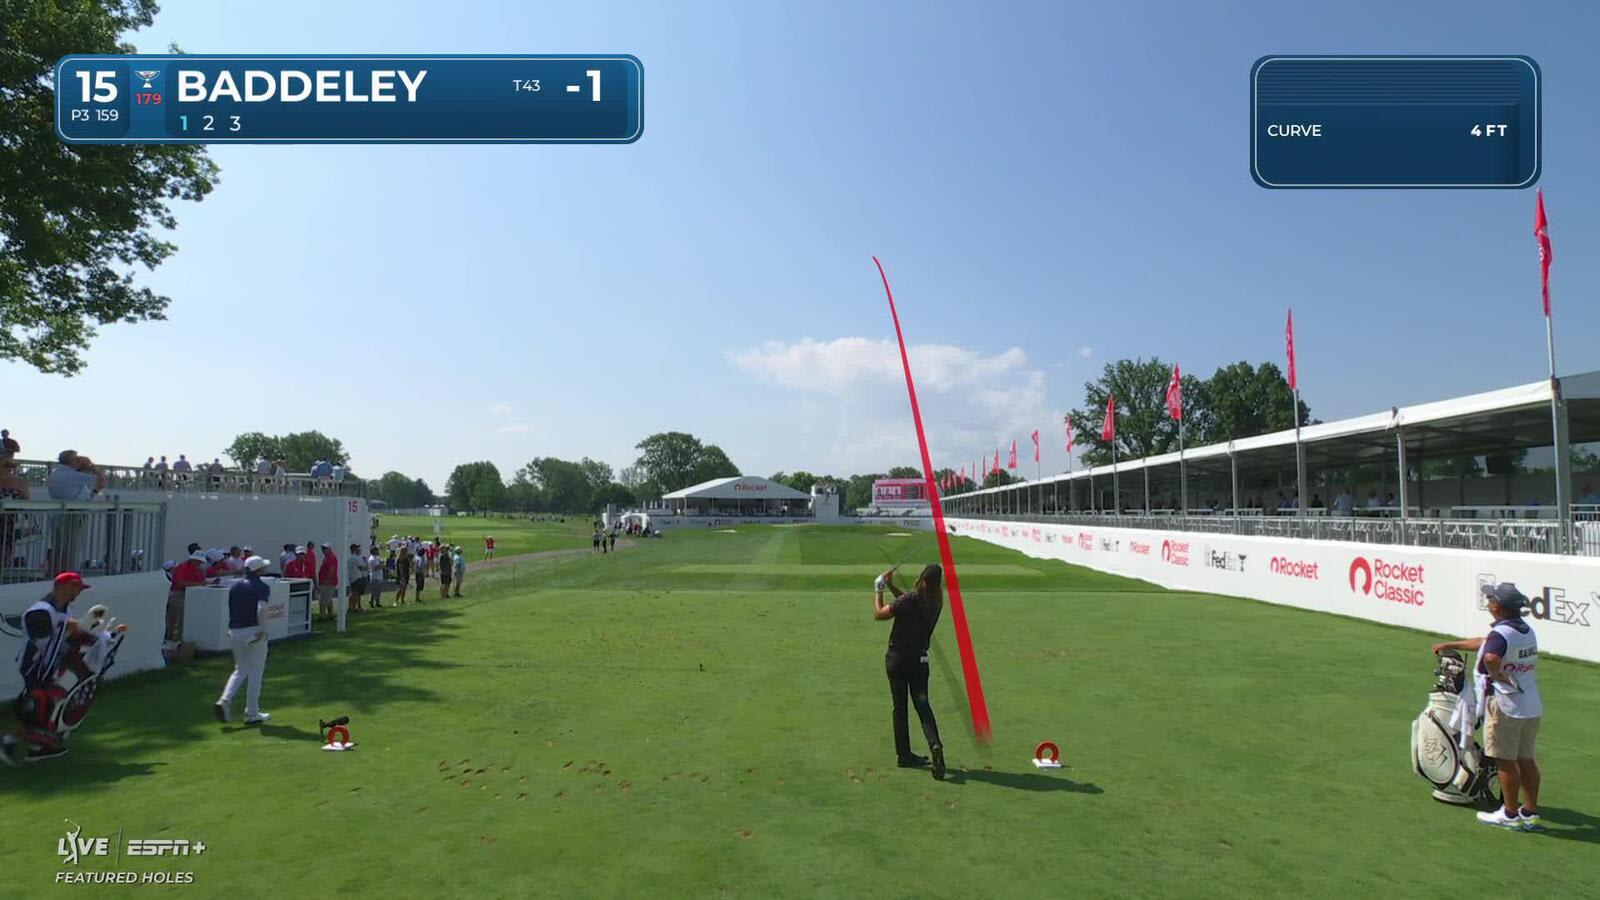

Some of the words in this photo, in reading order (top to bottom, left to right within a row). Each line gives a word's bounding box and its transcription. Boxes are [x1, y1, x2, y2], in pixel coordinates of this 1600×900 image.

[1279, 556, 1319, 580] Rocket
[1374, 557, 1425, 584] Rocket
[1374, 579, 1425, 606] Classic
